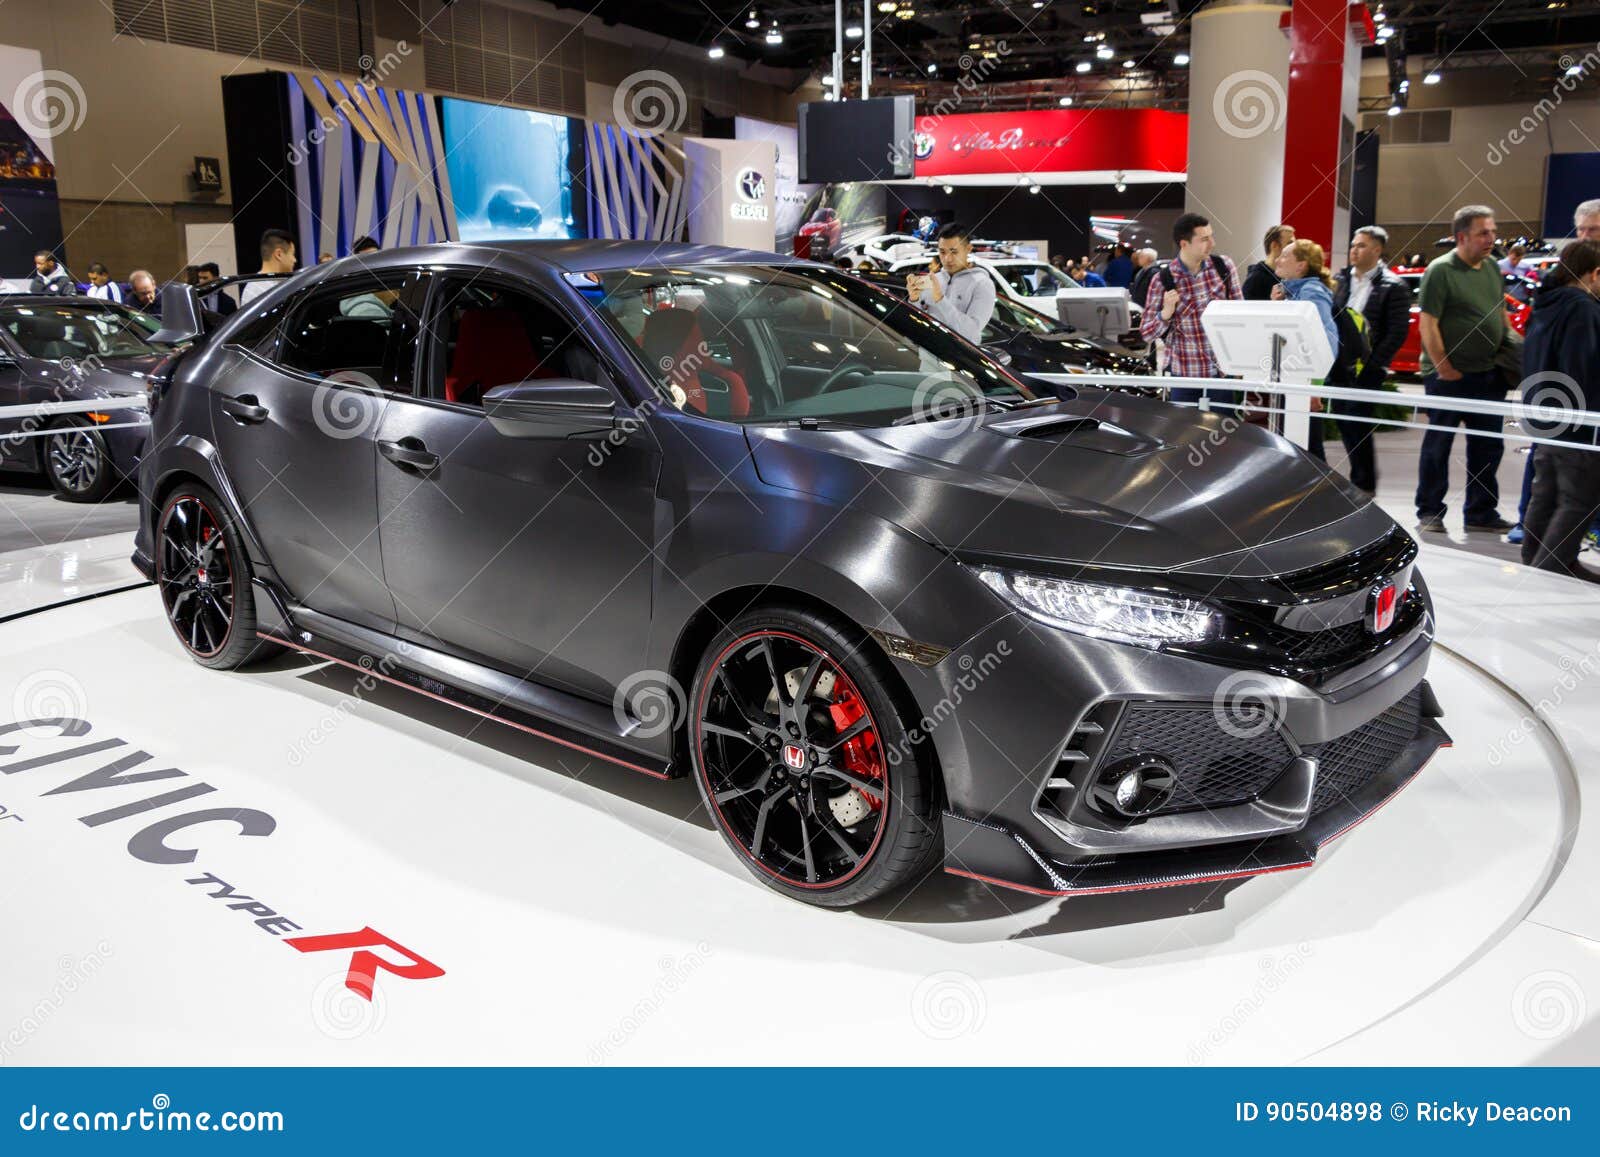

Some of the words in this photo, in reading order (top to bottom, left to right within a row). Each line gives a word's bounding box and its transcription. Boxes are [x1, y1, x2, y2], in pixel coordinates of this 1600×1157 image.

[0, 717, 277, 865] CIVIC
[184, 872, 303, 936] TYPE
[282, 926, 446, 1002] R
